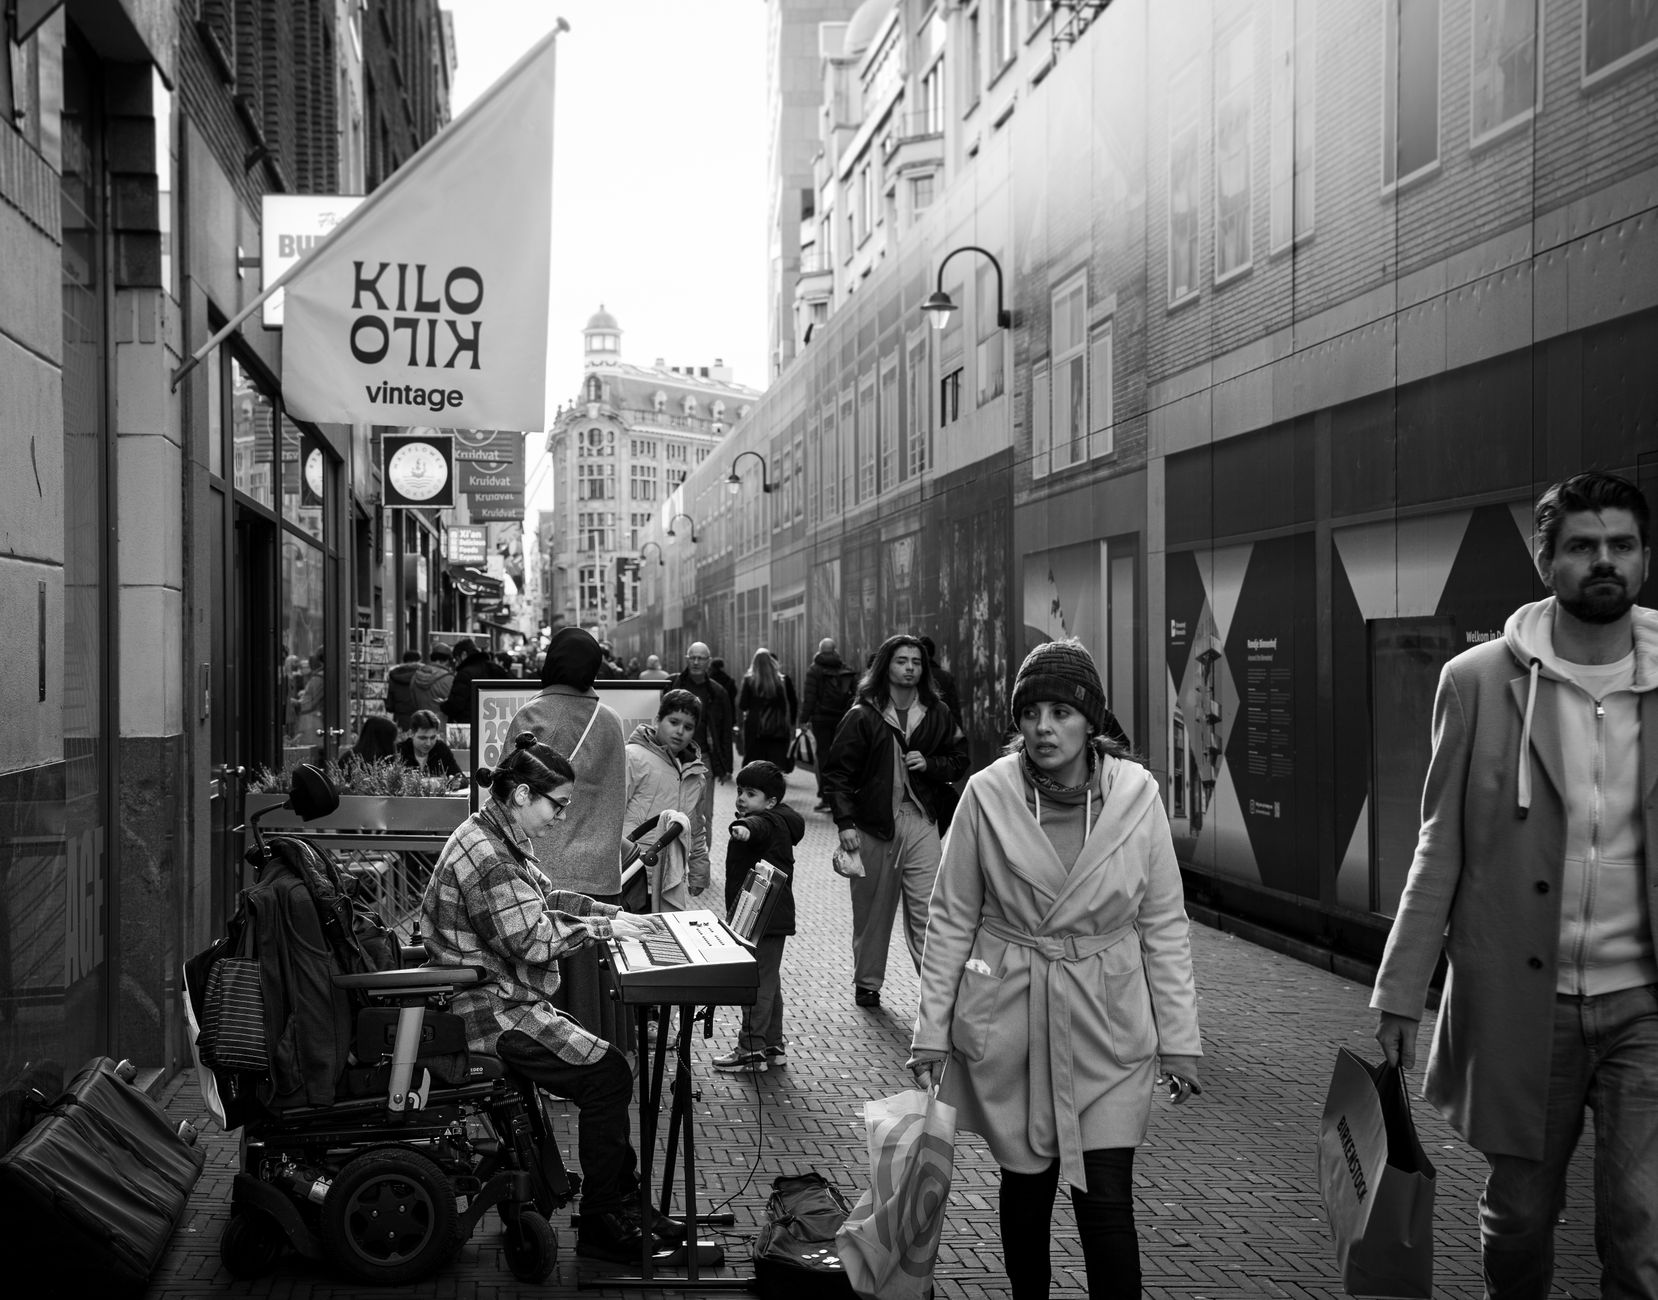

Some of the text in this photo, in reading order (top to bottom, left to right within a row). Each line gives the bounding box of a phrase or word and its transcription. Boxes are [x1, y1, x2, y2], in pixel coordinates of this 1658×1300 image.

[279, 234, 328, 258] BU
[351, 261, 484, 315] KILO
[365, 380, 464, 412] vintage
[469, 475, 511, 486] Kruidvat
[481, 508, 517, 518] Kruidvat
[1466, 631, 1489, 643] Welkom
[483, 697, 532, 720] STU
[1337, 1114, 1368, 1204] BIRKENSTOCK
